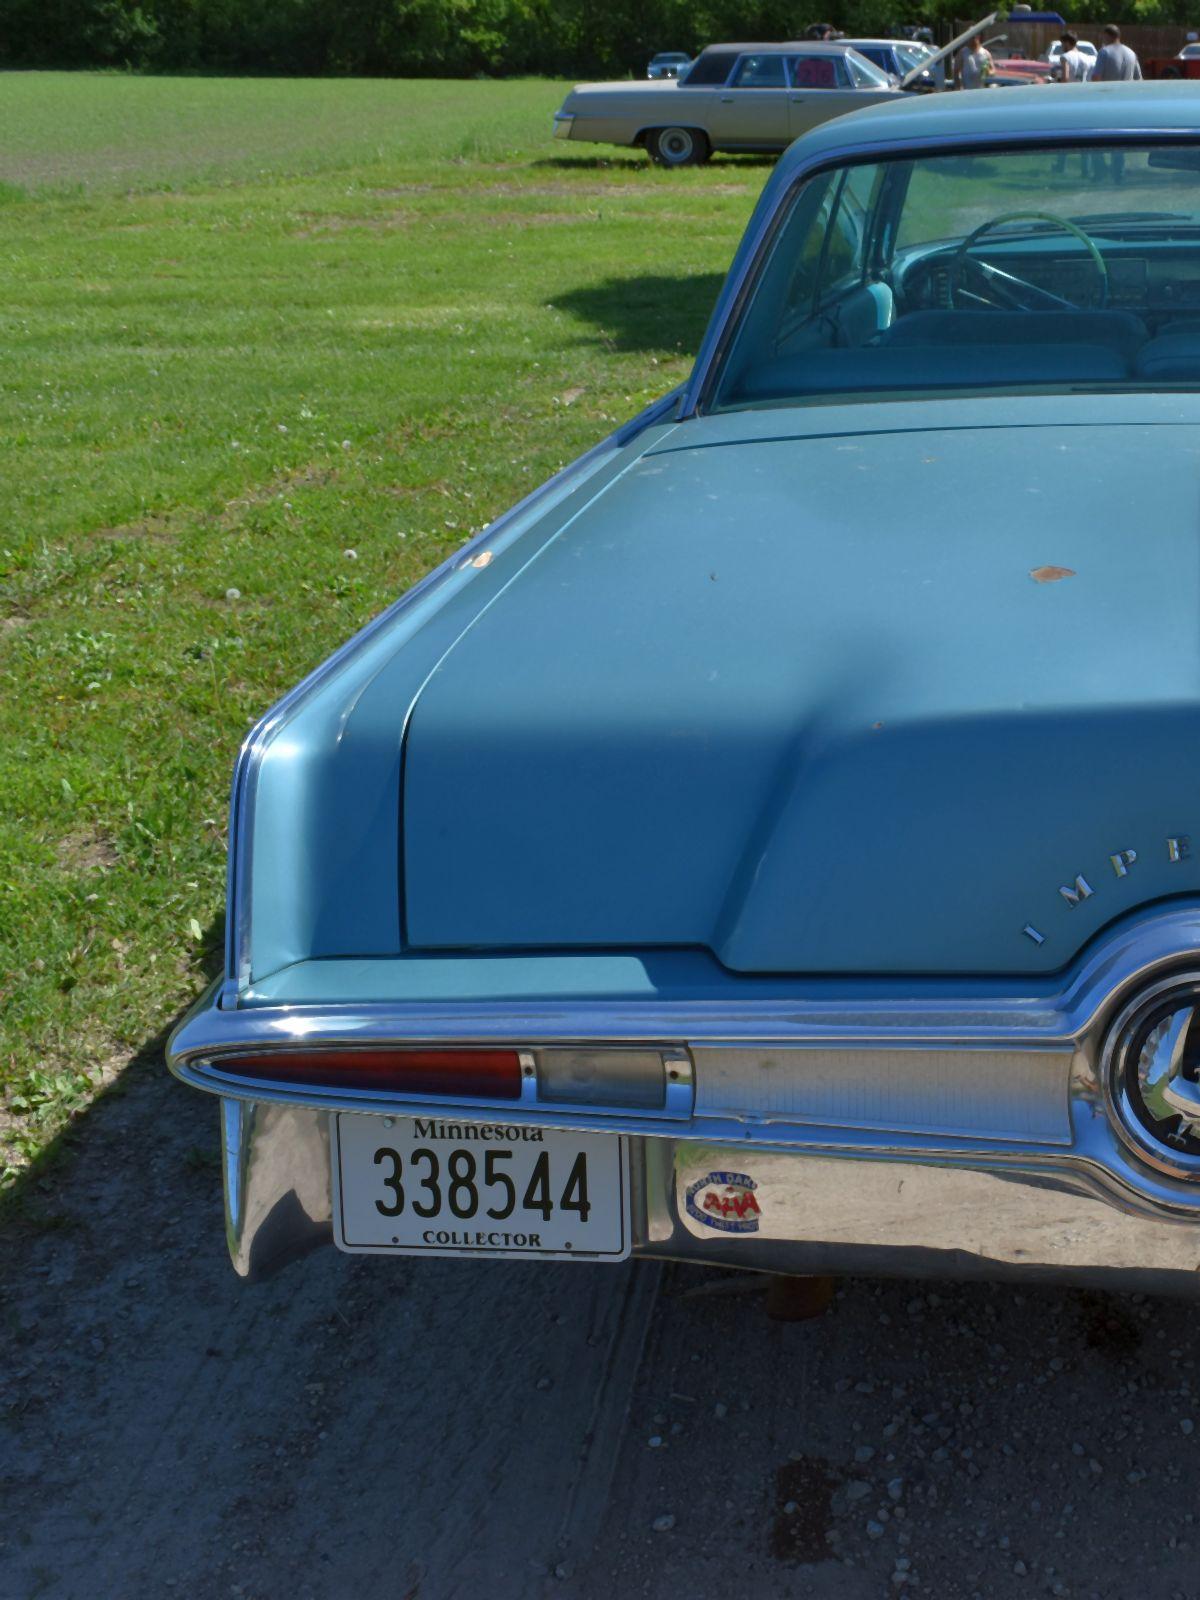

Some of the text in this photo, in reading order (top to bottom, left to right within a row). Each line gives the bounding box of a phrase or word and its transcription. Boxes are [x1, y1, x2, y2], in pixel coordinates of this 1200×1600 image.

[413, 1119, 544, 1142] Minnesota
[373, 1147, 591, 1222] 338544
[422, 1230, 542, 1247] COLLECTOR
